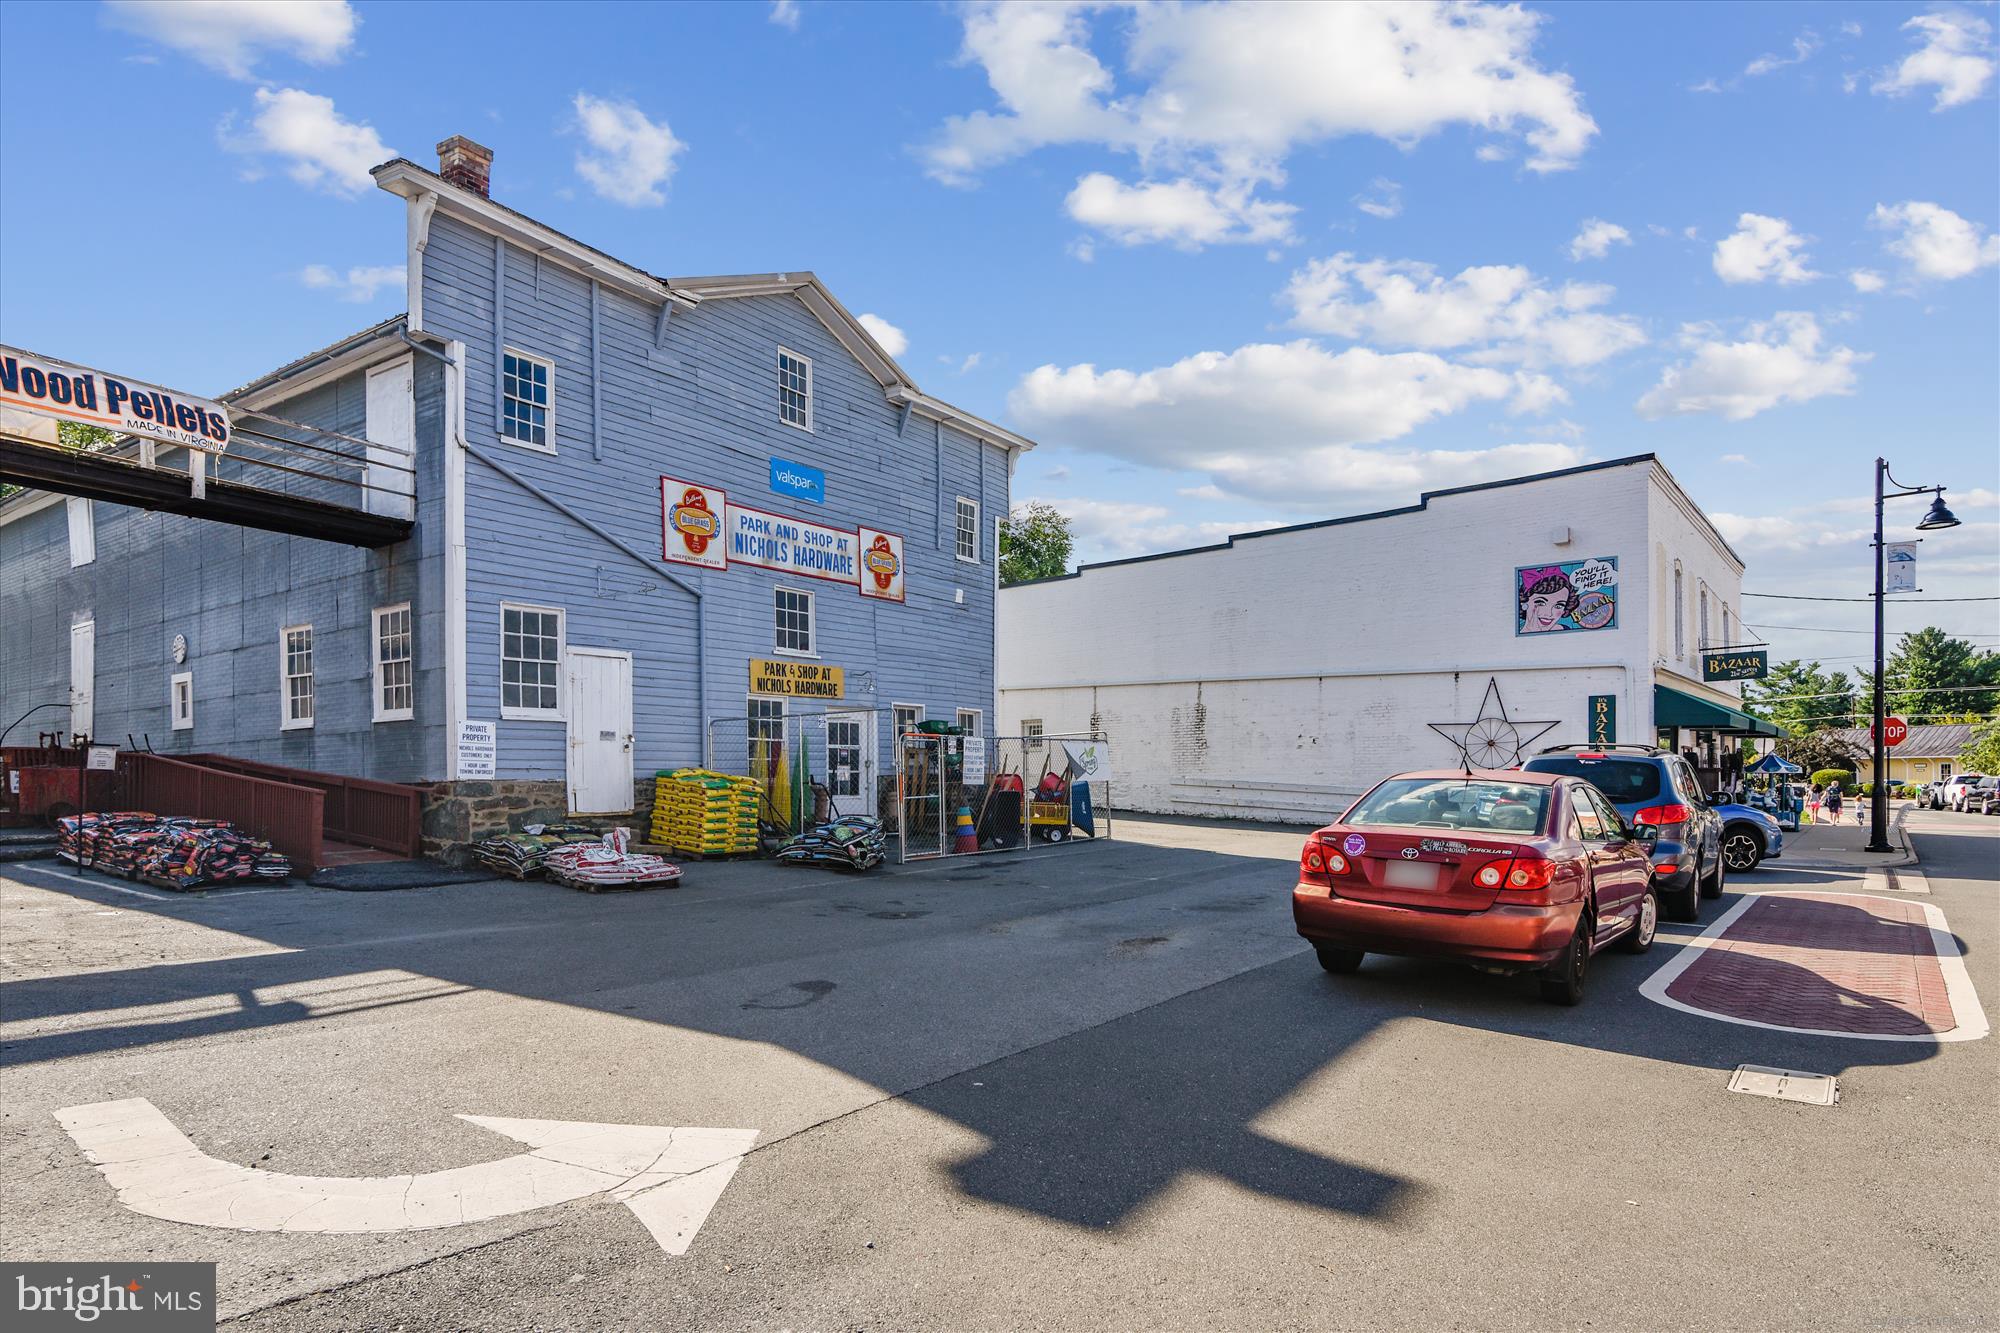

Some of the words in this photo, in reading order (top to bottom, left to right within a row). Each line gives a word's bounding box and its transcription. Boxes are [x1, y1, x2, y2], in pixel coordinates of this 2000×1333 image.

[104, 378, 228, 441] Pellets
[127, 419, 163, 434] MADE
[167, 429, 176, 439] IN
[181, 433, 224, 451] VIRGINIA
[775, 469, 811, 489] valspar
[740, 515, 772, 536] PARK
[776, 523, 799, 541] AND
[804, 530, 833, 548] SHOP
[837, 538, 849, 553] AT
[672, 553, 702, 563] INDEPENDENT
[735, 532, 788, 562] NICHOLS
[793, 545, 853, 575] HARDWARE
[1575, 564, 1607, 577] YOU'LL
[1575, 573, 1597, 584] FIND
[1600, 570, 1609, 578] IT
[1583, 577, 1612, 589] HERE!
[765, 662, 787, 677] PARK
[790, 664, 795, 678] &
[797, 665, 818, 679] SHOP
[821, 668, 831, 680] AT
[1708, 657, 1762, 673] BAZAAR
[757, 678, 791, 693] NICHOLS
[795, 681, 838, 696] HARDWARE
[465, 725, 487, 733] PRIVATE
[1883, 726, 1905, 738] TOP
[1467, 846, 1501, 854] COROLLA
